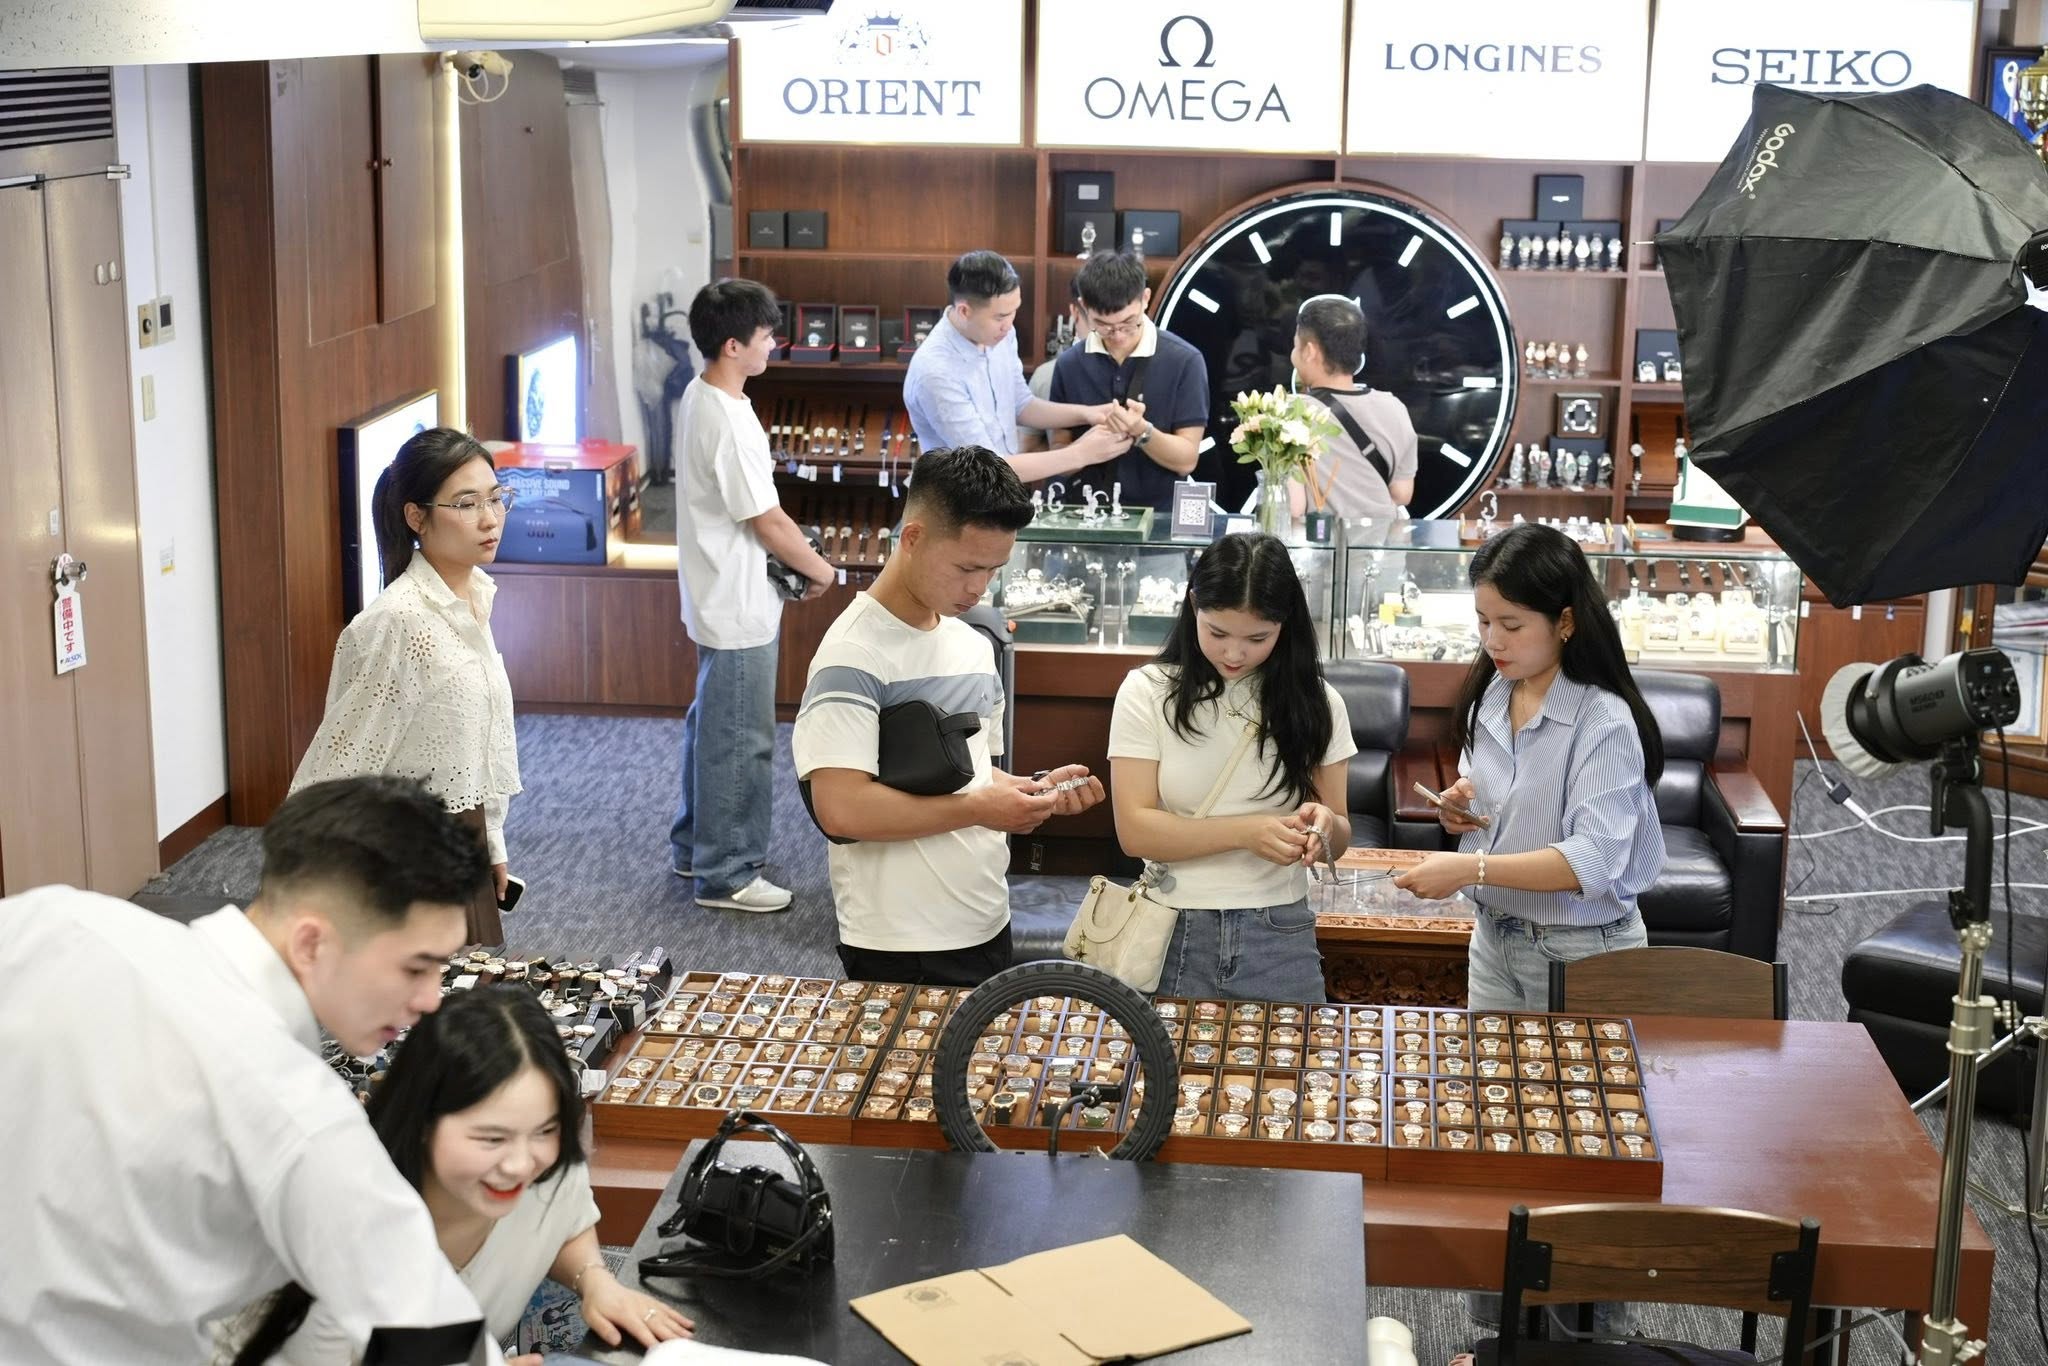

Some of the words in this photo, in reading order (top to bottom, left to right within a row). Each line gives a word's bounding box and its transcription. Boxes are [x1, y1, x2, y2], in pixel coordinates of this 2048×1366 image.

[1384, 43, 1602, 74] LONGINES
[1712, 47, 1912, 87] SEIKO
[783, 77, 980, 116] ORIENT
[1085, 77, 1291, 122] OMEGA
